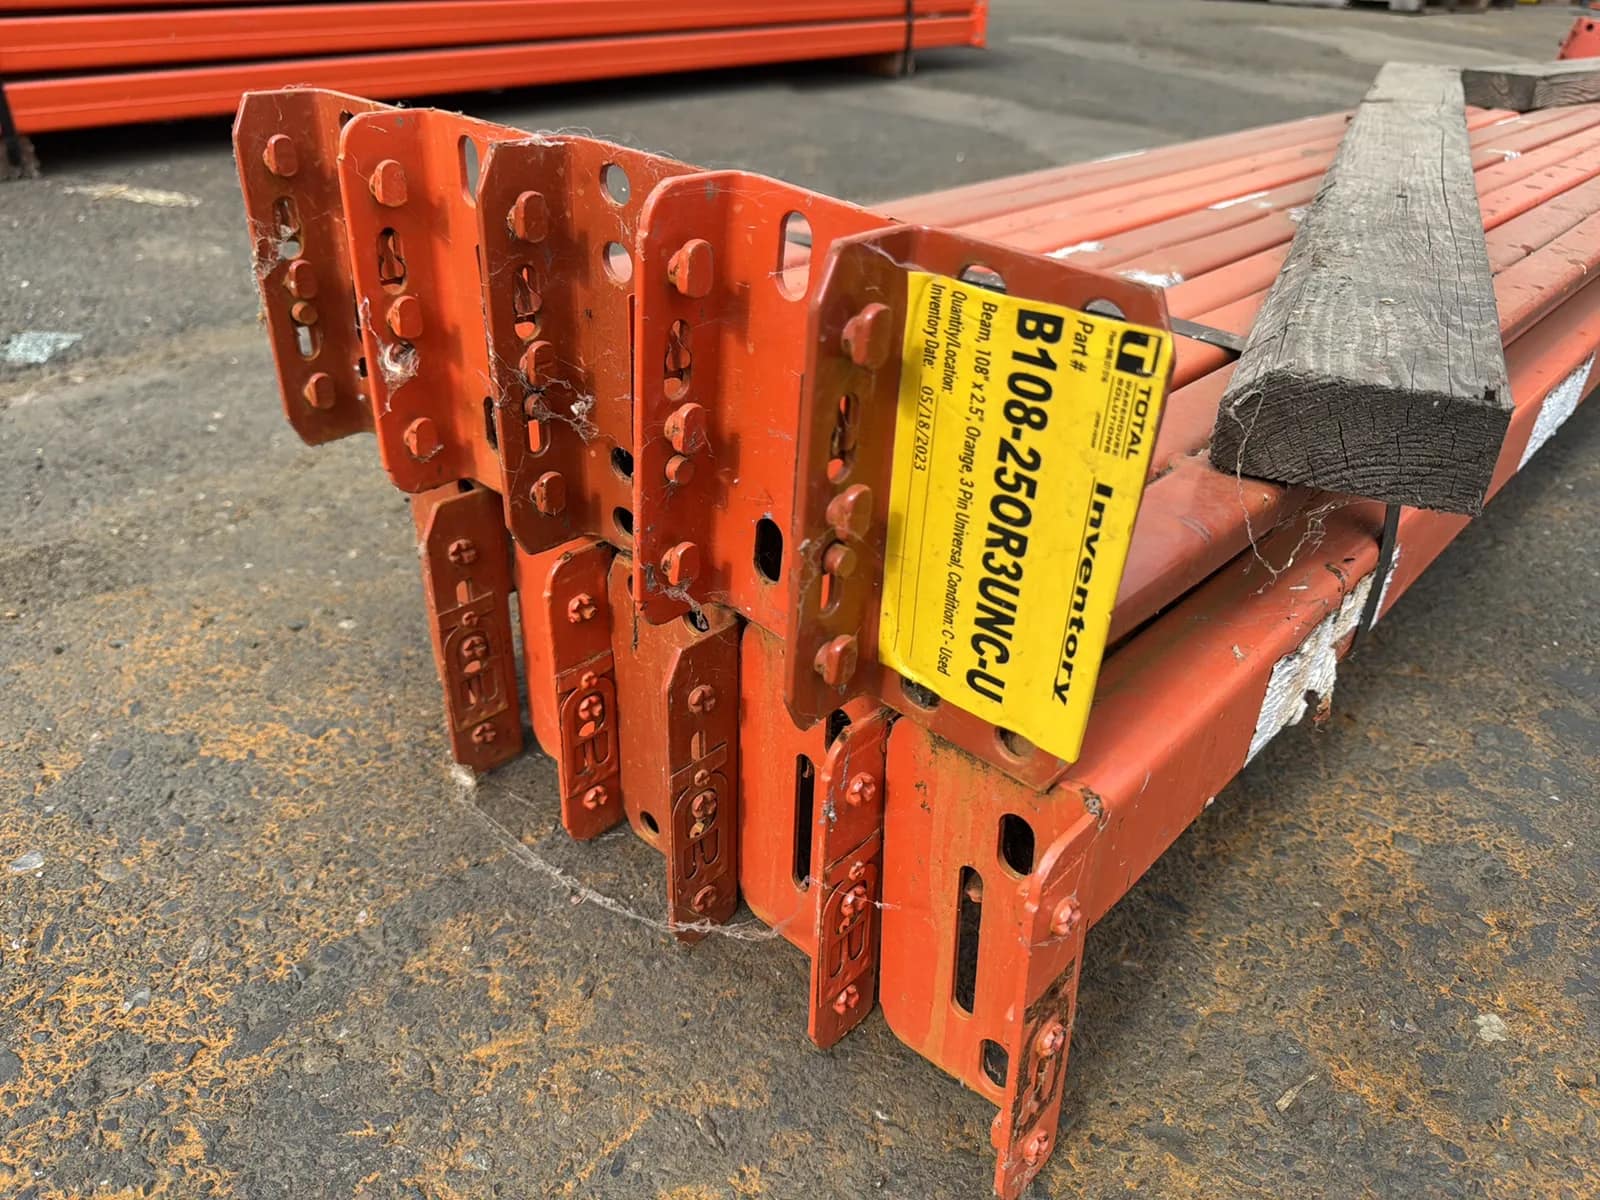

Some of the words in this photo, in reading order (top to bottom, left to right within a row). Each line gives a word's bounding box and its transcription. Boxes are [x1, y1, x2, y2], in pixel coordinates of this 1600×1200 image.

[922, 283, 945, 339] Inventory
[975, 301, 998, 343] Beam,
[922, 338, 938, 370] Date:
[944, 290, 968, 394] Quantity/Location:
[1071, 319, 1095, 357] Part
[971, 381, 984, 392] x
[973, 349, 992, 382] 108"
[1069, 359, 1087, 373] #
[913, 385, 934, 472] 05/18/2023
[965, 392, 987, 423] 2.5",
[1103, 377, 1124, 454] SOLUTIONS
[1112, 381, 1132, 456] WAREHOUSE
[1125, 386, 1152, 460] TOTAL
[958, 425, 982, 474] Orange,
[956, 487, 974, 511] Pin
[959, 477, 975, 489] 3
[947, 511, 970, 569] Universal,
[942, 571, 963, 629] Condition:
[1051, 482, 1114, 707] Inventory
[941, 629, 955, 640] C
[936, 646, 953, 677] Used
